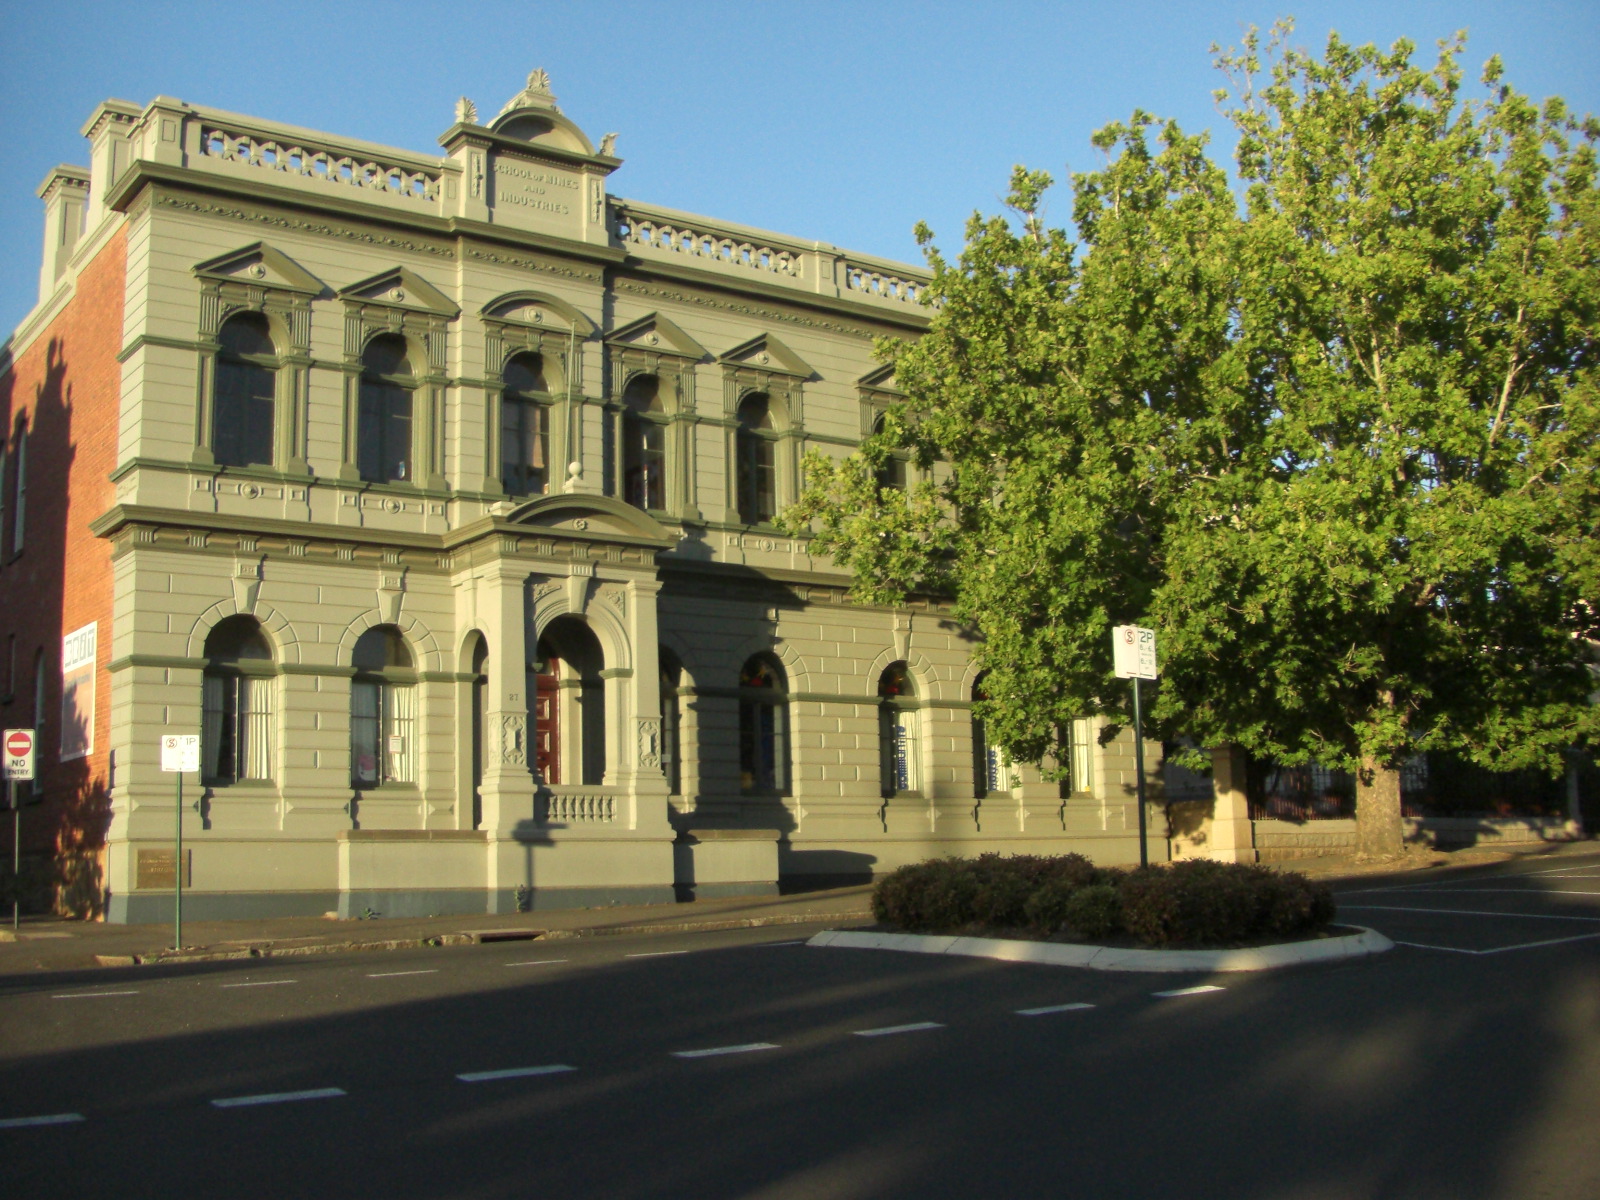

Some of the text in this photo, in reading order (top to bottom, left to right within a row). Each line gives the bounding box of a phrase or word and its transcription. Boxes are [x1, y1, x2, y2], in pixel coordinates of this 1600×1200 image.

[493, 163, 579, 190] SCHOOL OF MINES
[525, 185, 545, 195] AND
[499, 192, 569, 215] INDUSTRIES
[1140, 631, 1152, 643] 2P
[509, 693, 518, 701] 27
[185, 737, 197, 746] 1P
[11, 759, 26, 767] NO
